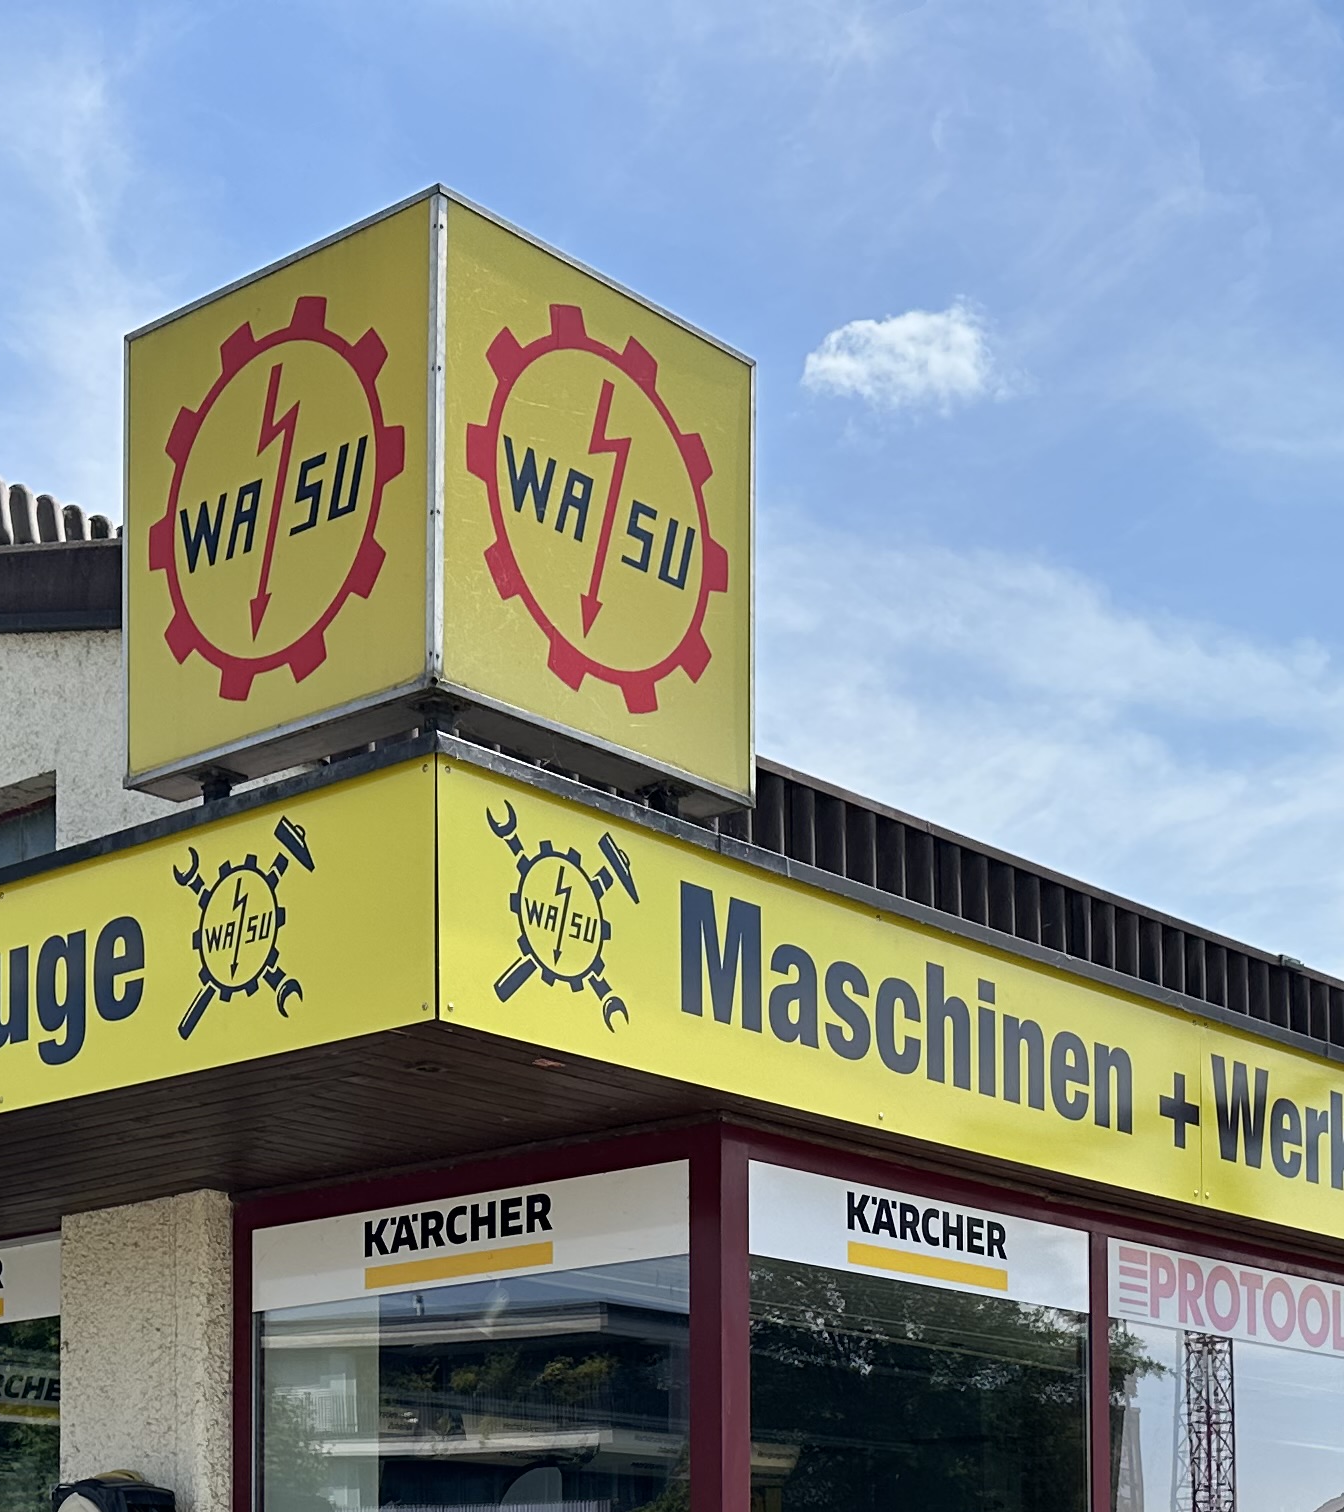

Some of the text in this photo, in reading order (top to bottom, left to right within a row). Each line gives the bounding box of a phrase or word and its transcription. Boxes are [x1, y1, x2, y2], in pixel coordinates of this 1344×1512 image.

[679, 880, 1133, 1136] Maschinen
[1159, 1072, 1200, 1150] +
[364, 1193, 554, 1258] KÄRCHER
[847, 1190, 1007, 1260] KÄRCHER
